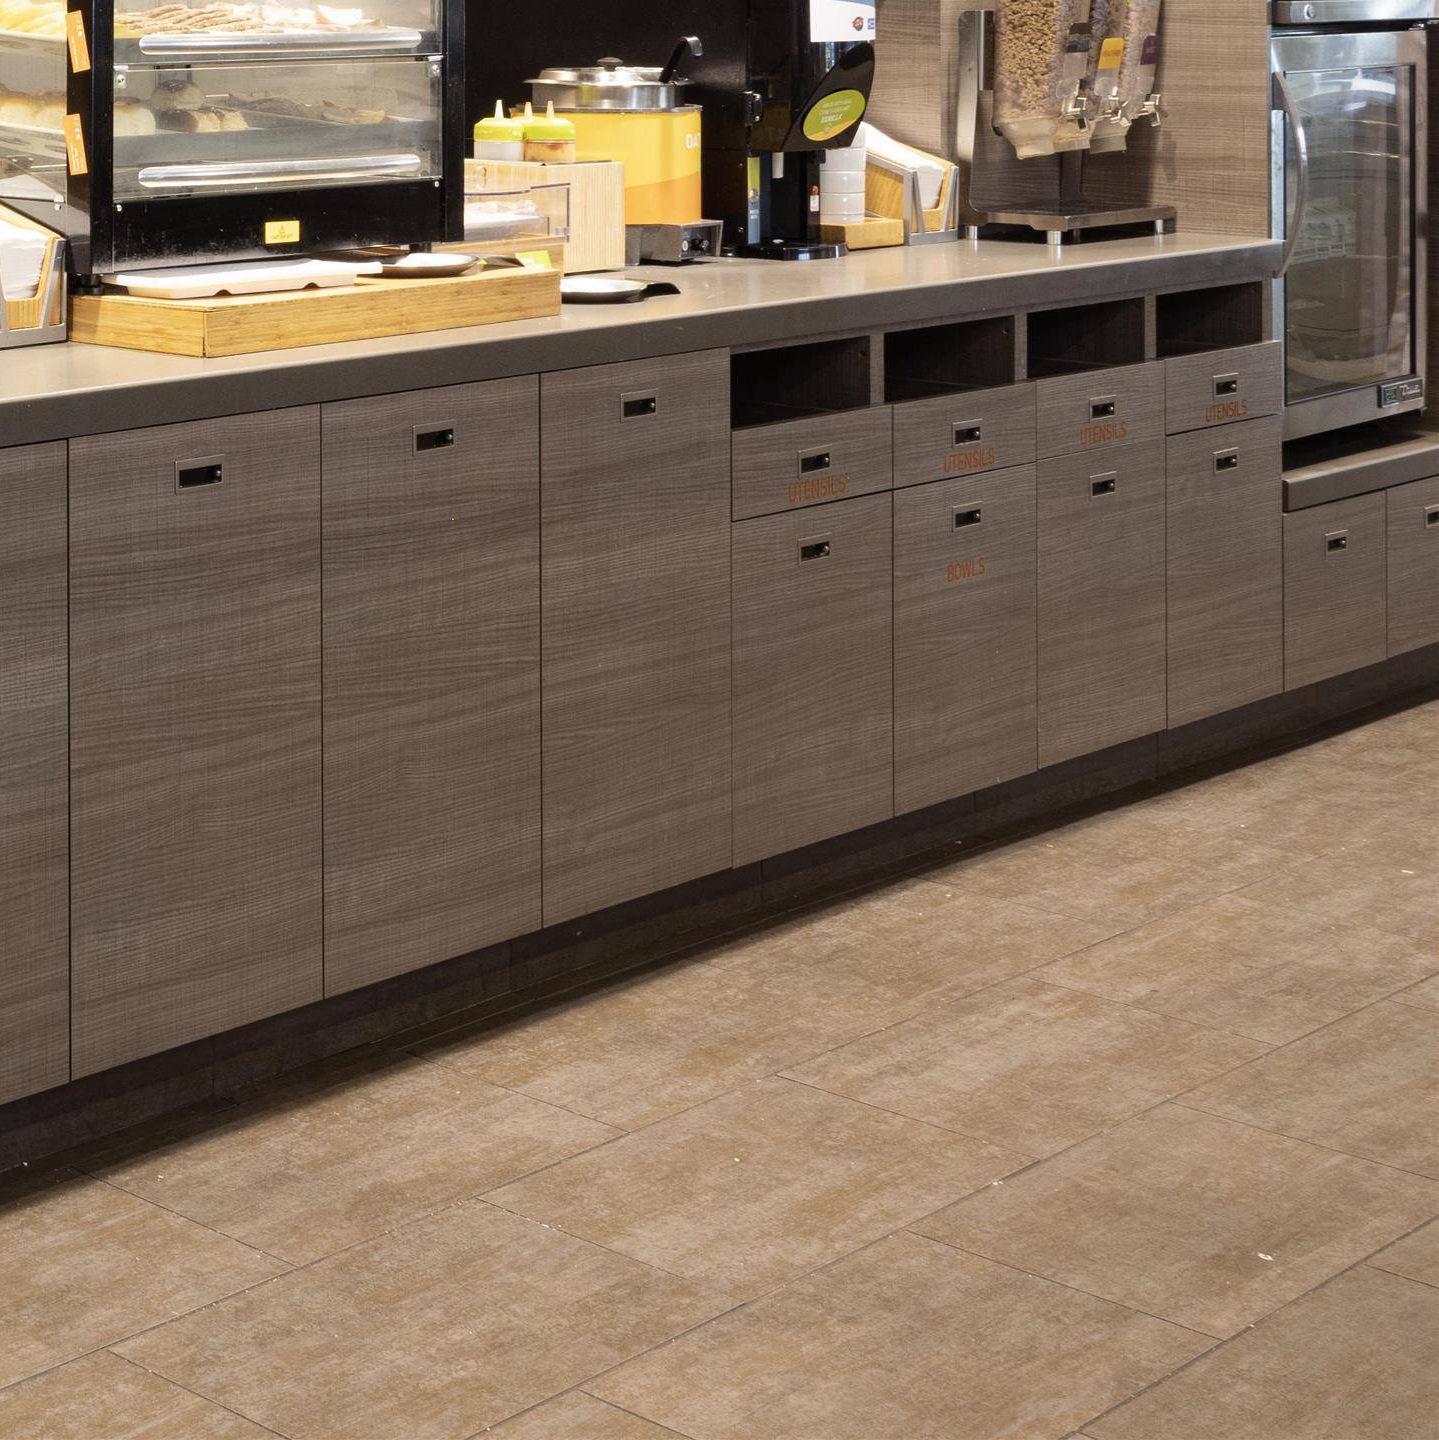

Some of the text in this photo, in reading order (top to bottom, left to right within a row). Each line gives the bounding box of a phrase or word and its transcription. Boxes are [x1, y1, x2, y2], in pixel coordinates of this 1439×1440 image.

[686, 133, 701, 149] OA
[1204, 400, 1248, 422] UTENSILS
[1079, 422, 1127, 445] UTENSILS
[943, 447, 995, 473] UTENSILS
[787, 473, 848, 503] UTENSILS
[947, 556, 986, 582] BOWLS
